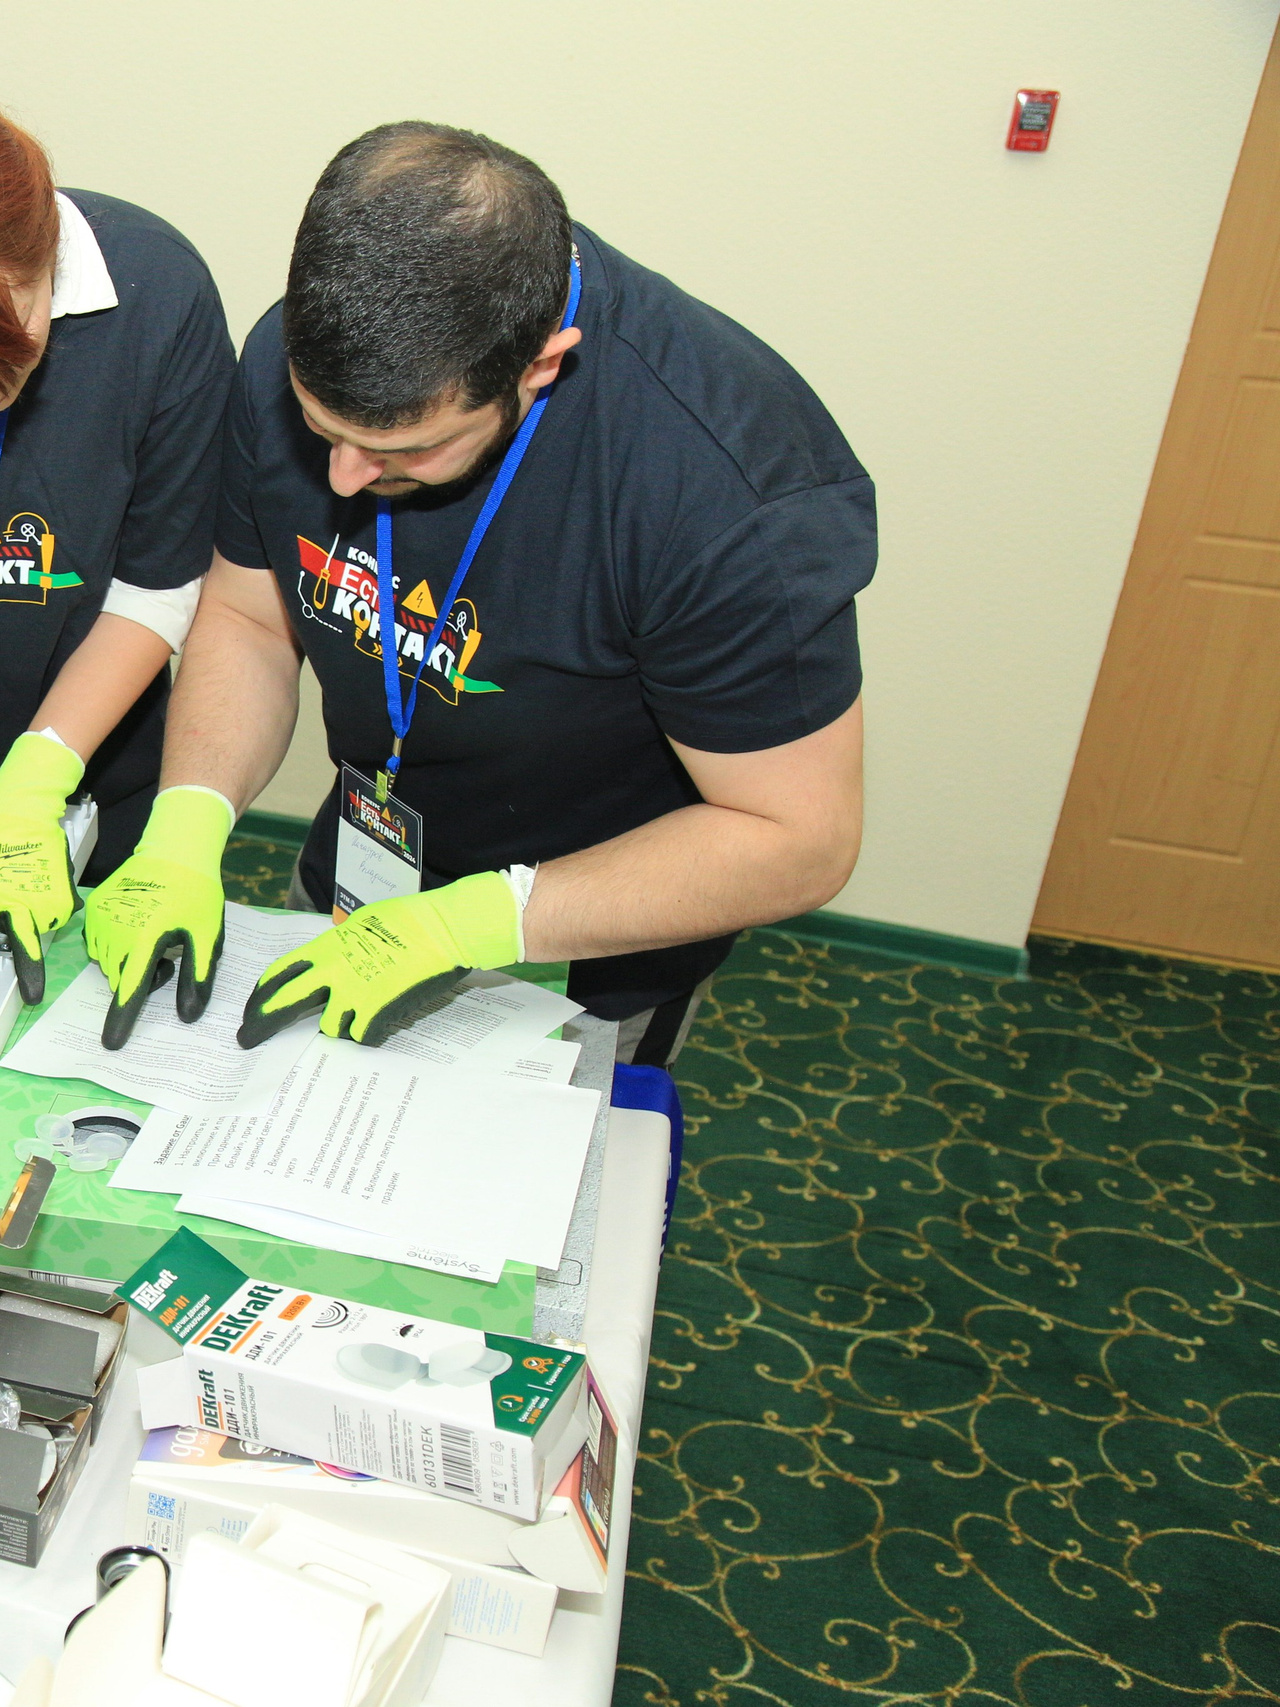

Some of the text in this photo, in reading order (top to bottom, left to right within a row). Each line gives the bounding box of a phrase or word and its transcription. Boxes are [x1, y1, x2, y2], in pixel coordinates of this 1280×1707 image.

[339, 562, 380, 608] Ест
[360, 812, 401, 845] КОНТАКТ
[403, 851, 416, 864] 2024
[362, 912, 405, 948] Milwaukee
[267, 1133, 290, 1167] Включить
[285, 1112, 302, 1133] лампу
[297, 1081, 315, 1107] спальне
[312, 1052, 329, 1077] режиме
[306, 1141, 330, 1176] Настроить
[324, 1104, 346, 1142] расписание
[340, 1073, 360, 1104] гостиной:
[153, 1129, 181, 1166] Задание от
[178, 1125, 204, 1159] Настроить
[240, 1124, 253, 1139] при
[322, 1134, 352, 1189] автоматическое
[346, 1100, 368, 1135] включение
[366, 1076, 379, 1090] утра
[363, 1158, 386, 1192] Включить
[379, 1139, 395, 1159] ленту
[389, 1104, 407, 1134] гостиной
[403, 1075, 419, 1100] режиме
[207, 1152, 222, 1168] При
[340, 1166, 358, 1194] режиме
[380, 1170, 400, 1205] праздник
[133, 1266, 178, 1310] DEKraft
[158, 1293, 190, 1326] ДДИ-101
[171, 1293, 211, 1333] ДАТЧИК ДВИЖЕНИЯ
[178, 1303, 212, 1339] ИНФРАКРАСНЫЙ
[199, 1283, 284, 1351] DEKraft
[283, 1297, 307, 1319] 1200 Вт
[244, 1328, 278, 1361] ДДИ-101
[198, 1370, 219, 1428] DEKraft
[223, 1388, 240, 1434] ДДИ-101
[237, 1372, 251, 1437] ДАТЧИК ДВИЖЕНИЯ
[248, 1384, 259, 1440] ИНФРАКРАСНЫЙ
[421, 1426, 436, 1487] 60131DEK
[511, 1447, 519, 1504] www.dekraft.com
[474, 1468, 482, 1492] 680409
